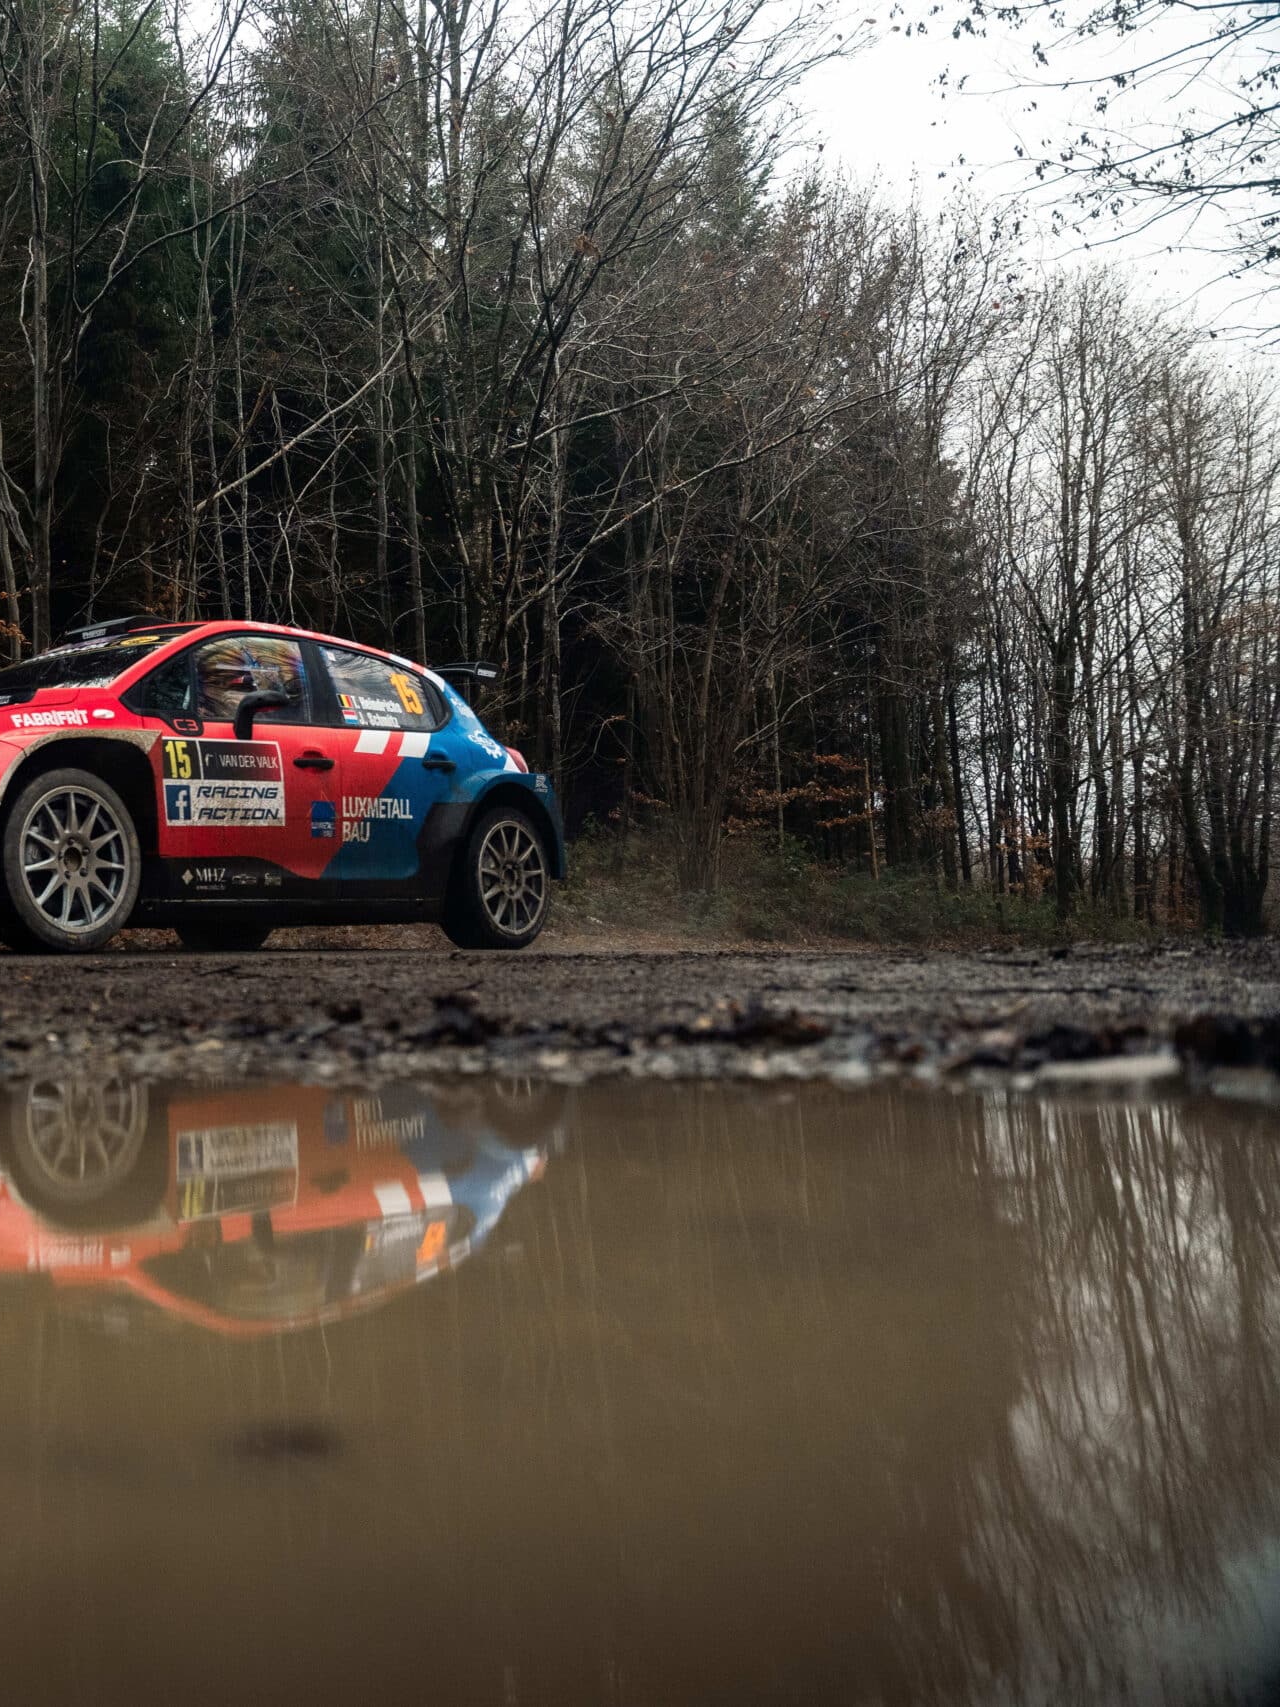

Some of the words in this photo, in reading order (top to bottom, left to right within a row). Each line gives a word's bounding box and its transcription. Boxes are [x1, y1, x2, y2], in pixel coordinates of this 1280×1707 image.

[389, 672, 424, 715] 15
[173, 719, 199, 731] C3
[165, 740, 192, 779] 15
[219, 754, 238, 767] VAN
[239, 755, 256, 768] DER
[255, 755, 278, 769] VALK
[196, 785, 279, 799] RACING
[198, 807, 280, 820] ACTION
[342, 796, 414, 820] LUXMETALL
[342, 821, 371, 842] BAU
[195, 867, 227, 883] MHZ
